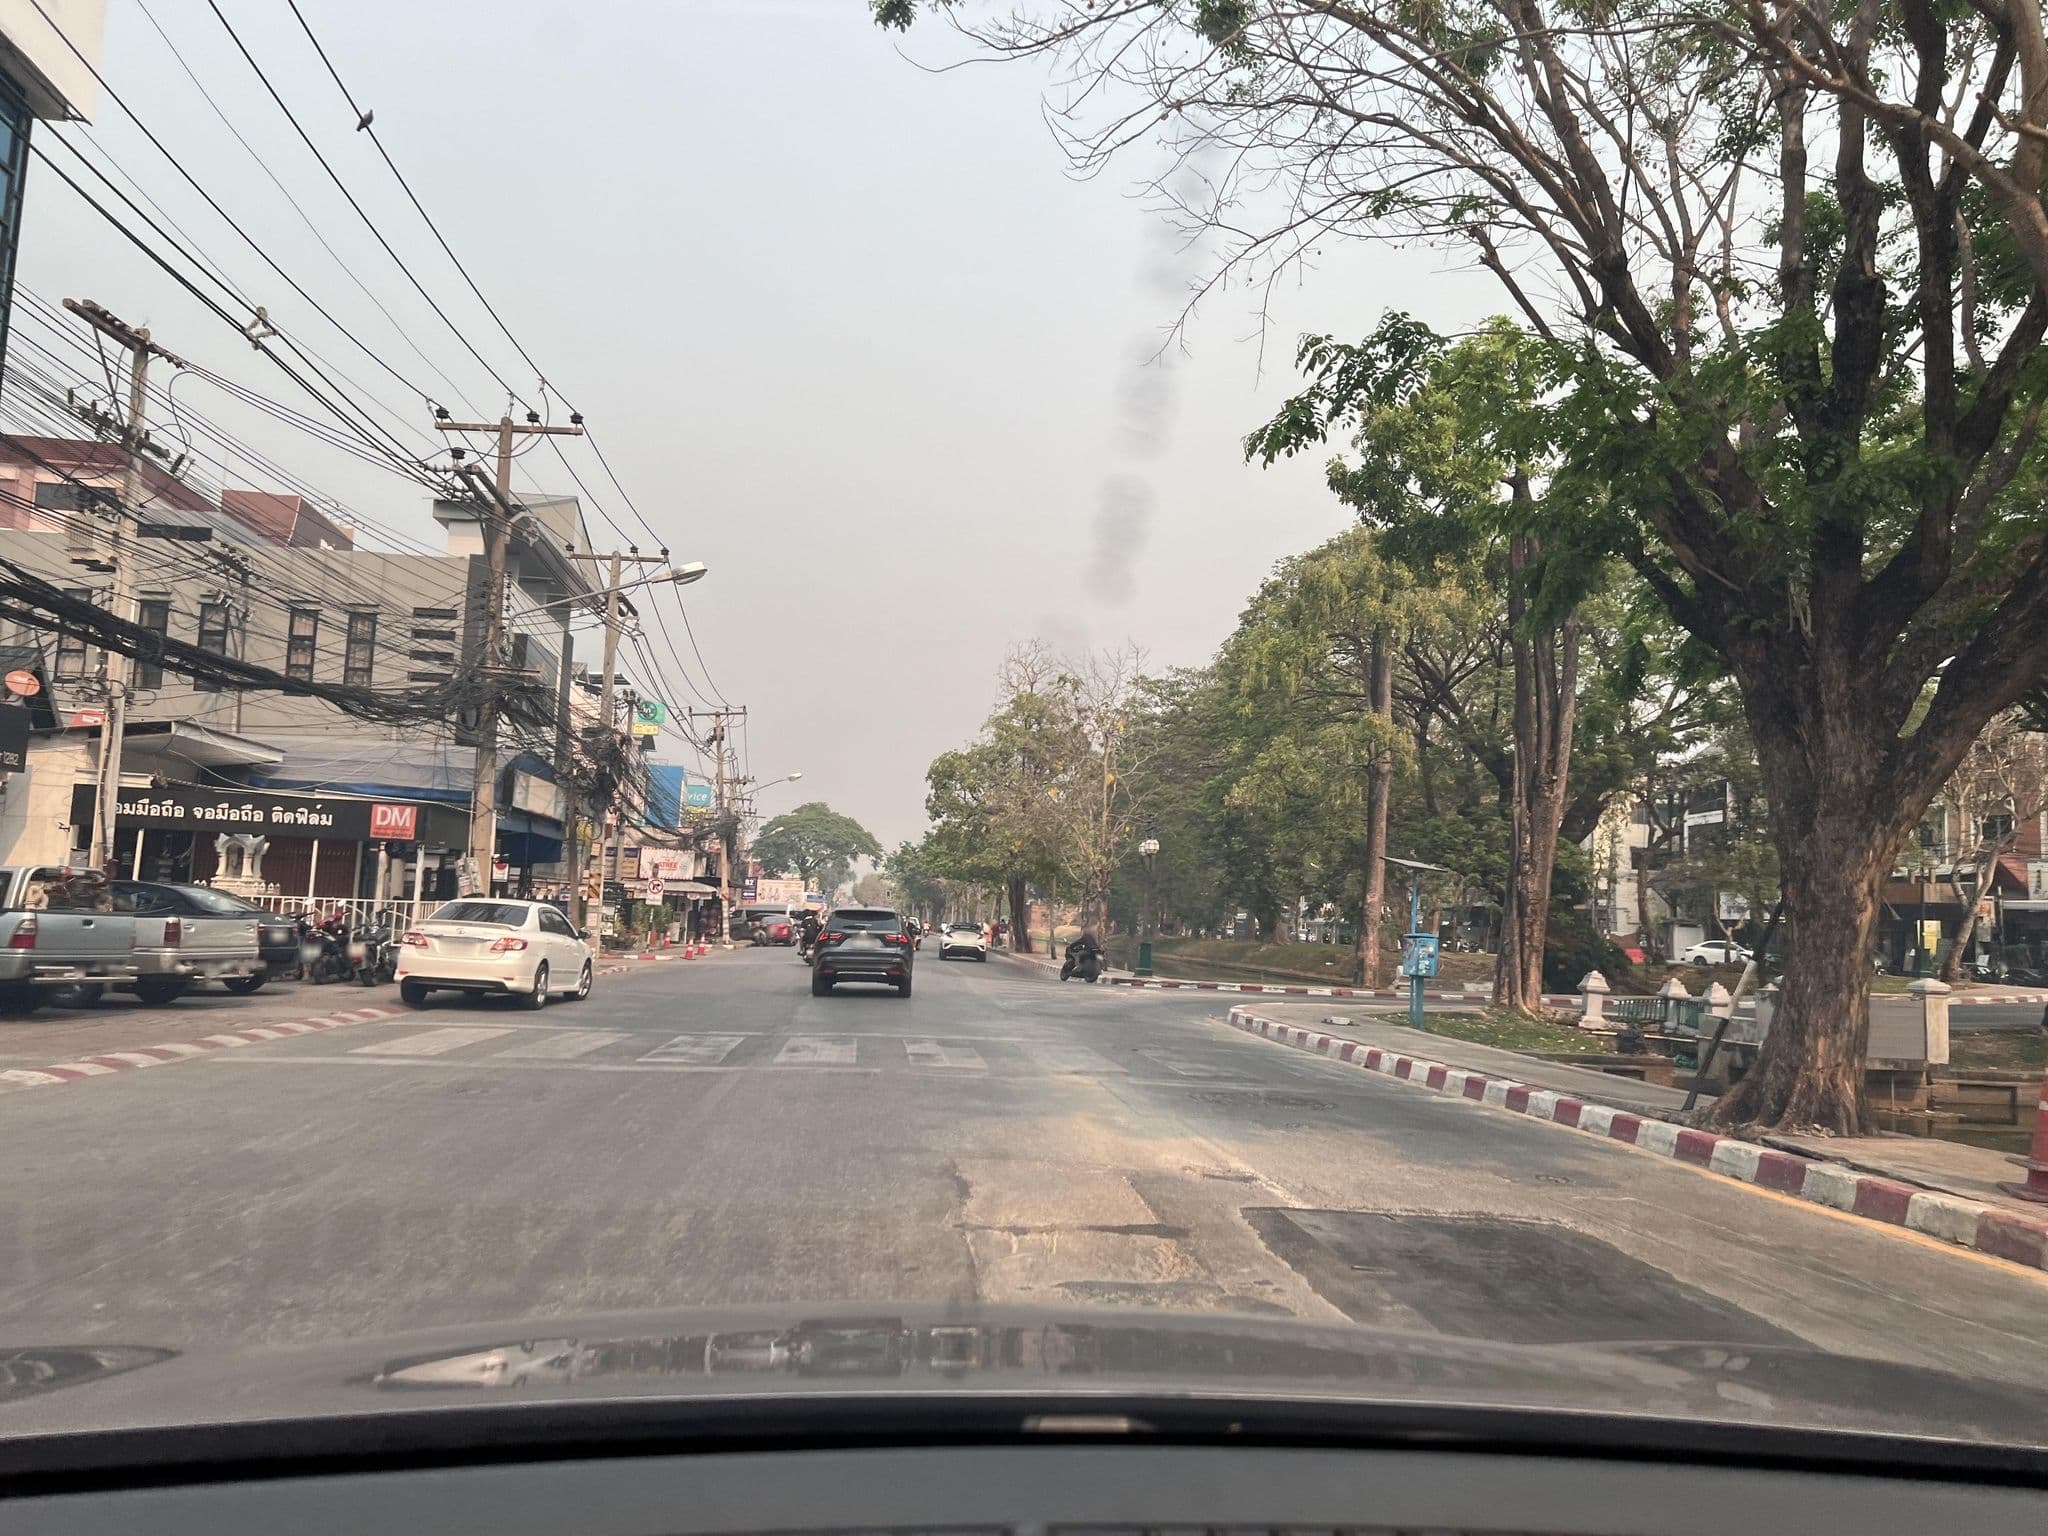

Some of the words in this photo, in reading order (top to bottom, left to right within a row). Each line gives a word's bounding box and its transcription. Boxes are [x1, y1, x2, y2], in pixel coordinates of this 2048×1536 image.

[116, 798, 185, 818] อมมือถือ
[192, 802, 264, 822] จอมือถือ
[271, 804, 333, 826] ติดฟิล์ม
[376, 806, 411, 827] DM
